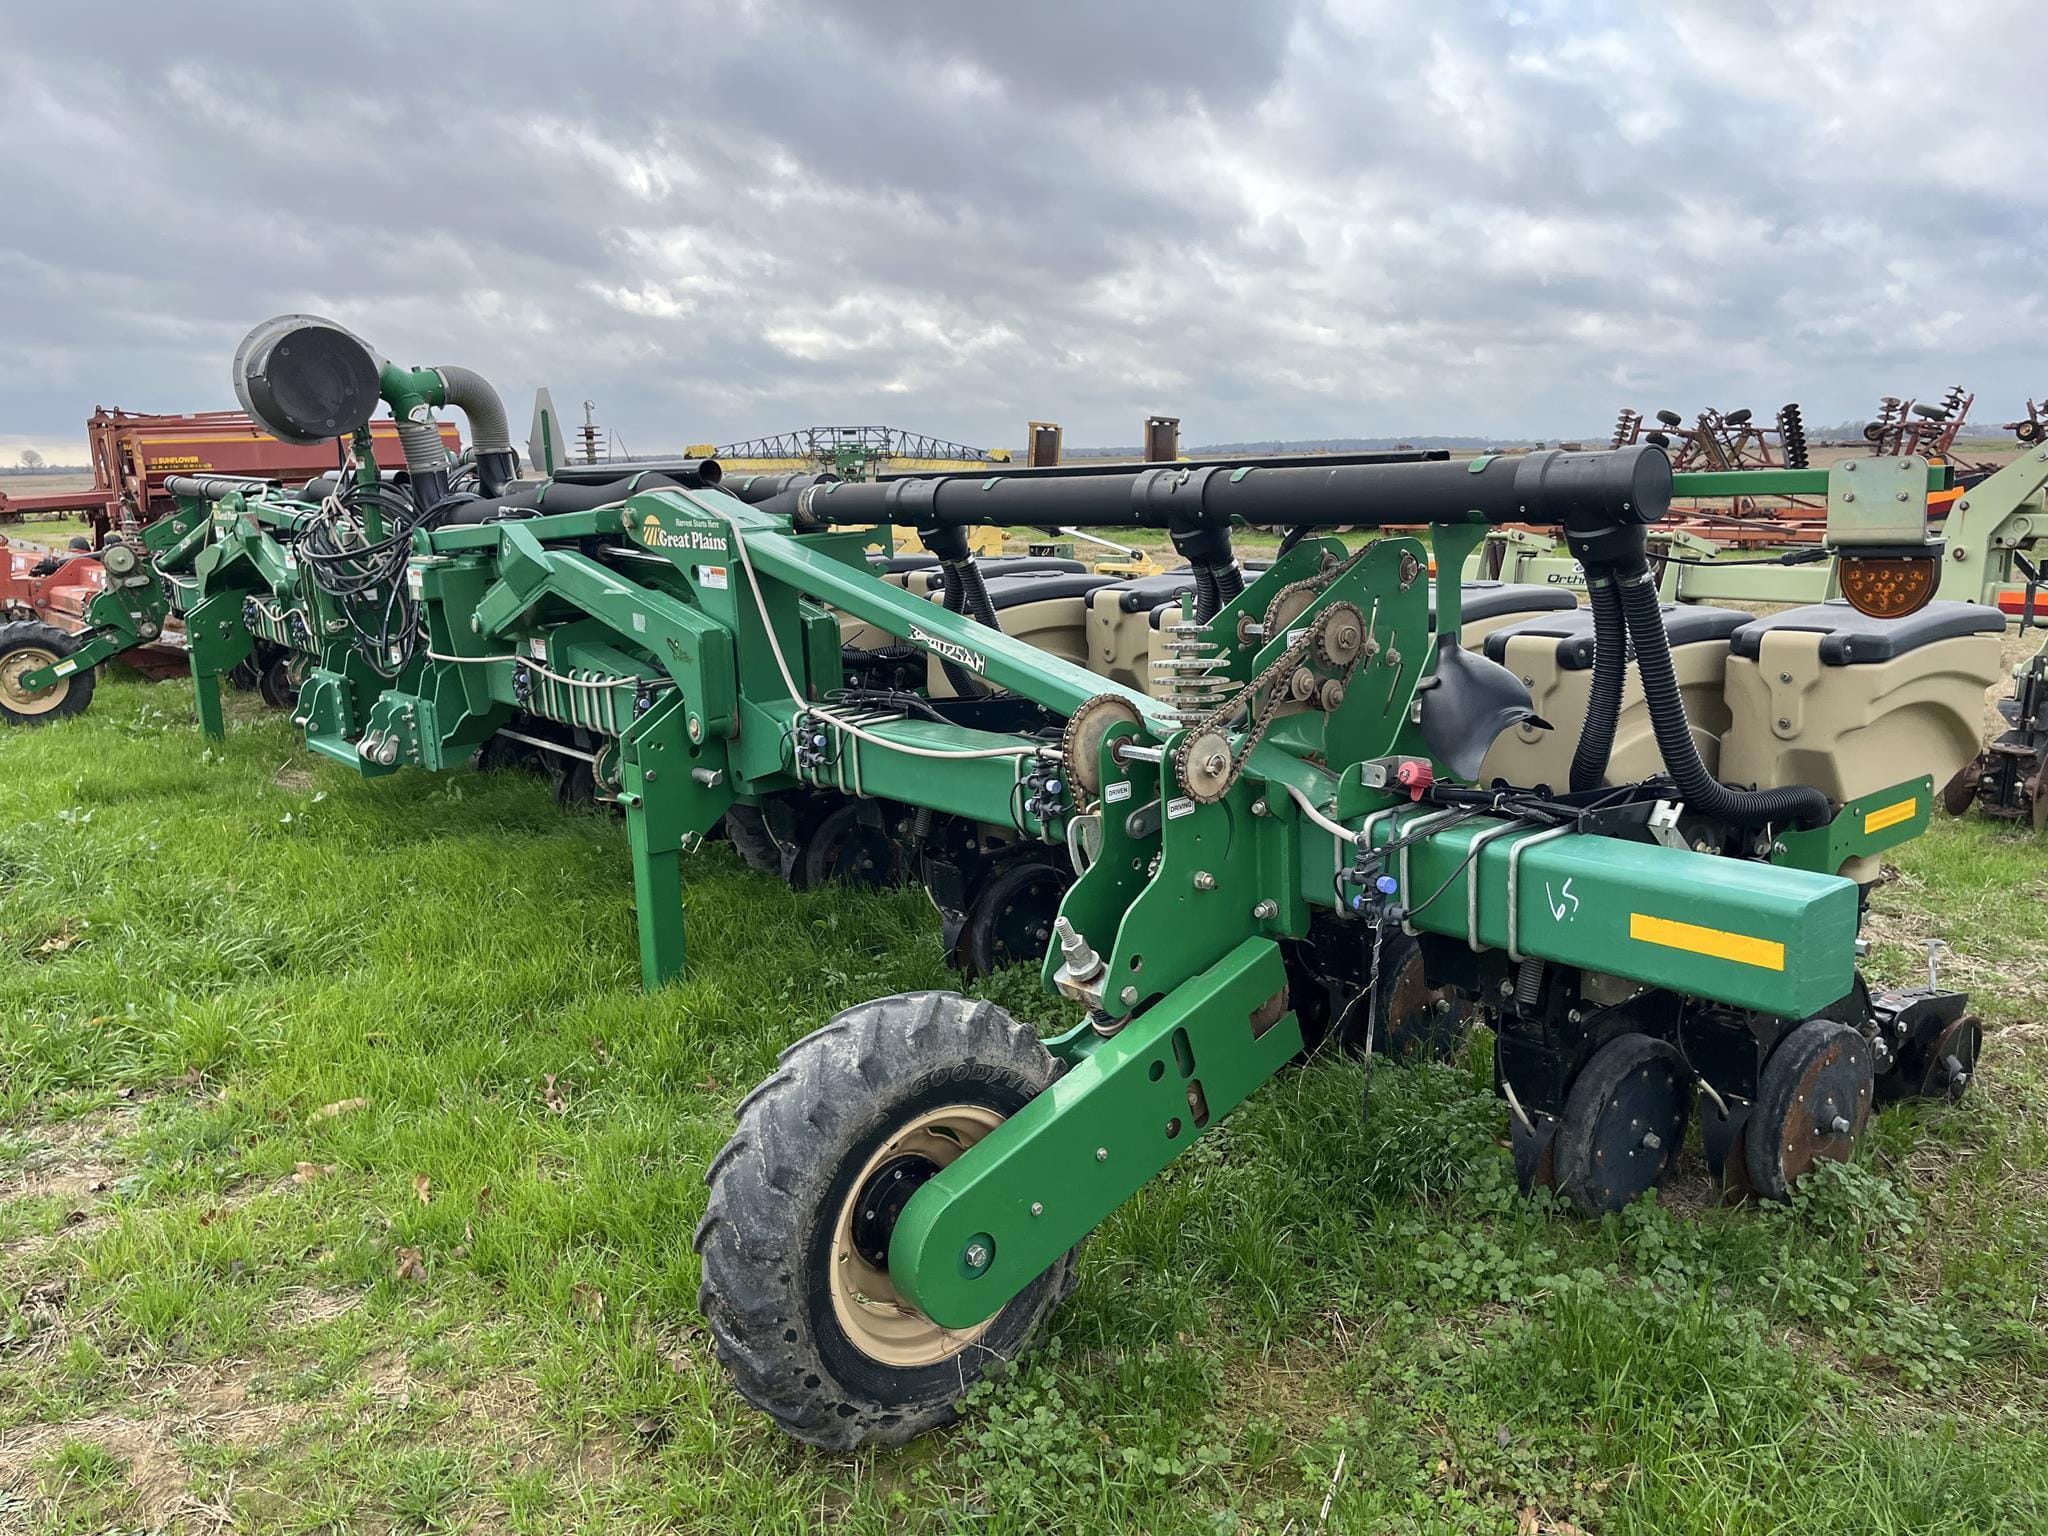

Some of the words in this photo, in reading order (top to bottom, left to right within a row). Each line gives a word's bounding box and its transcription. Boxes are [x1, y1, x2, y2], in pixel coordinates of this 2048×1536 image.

[159, 456, 199, 464] SUNFLOWER
[675, 518, 693, 527] Harvest
[693, 519, 707, 528] Starts
[708, 519, 720, 529] Here
[660, 530, 691, 548] Great
[691, 532, 727, 551] Plains
[1108, 787, 1128, 797] DRIVEN
[1170, 801, 1192, 813] DRIVING
